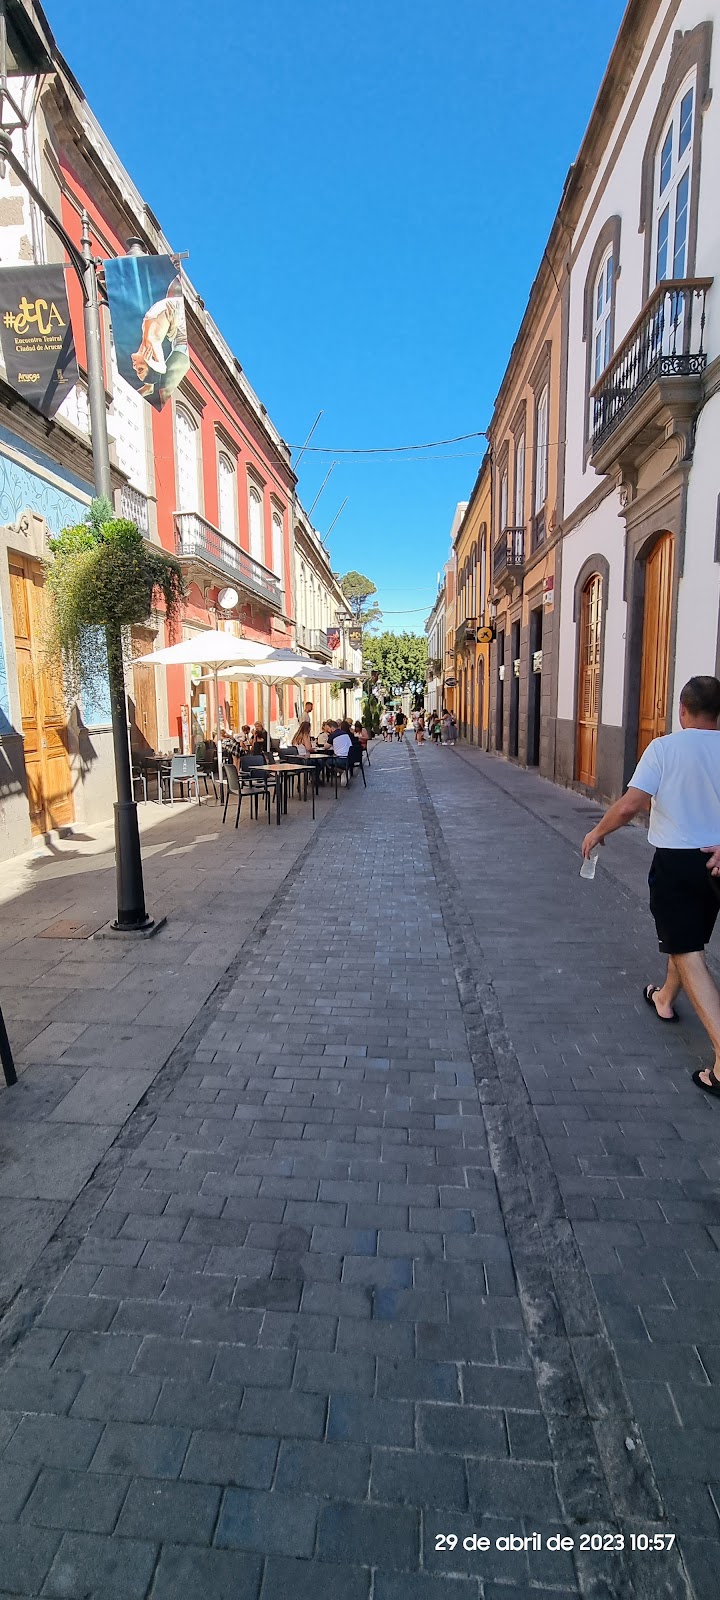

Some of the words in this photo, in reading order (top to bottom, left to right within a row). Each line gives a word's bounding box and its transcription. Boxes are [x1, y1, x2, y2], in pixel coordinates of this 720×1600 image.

[14, 336, 43, 345] Encuentro
[43, 335, 62, 343] Teatral
[16, 344, 36, 352] Ciudad
